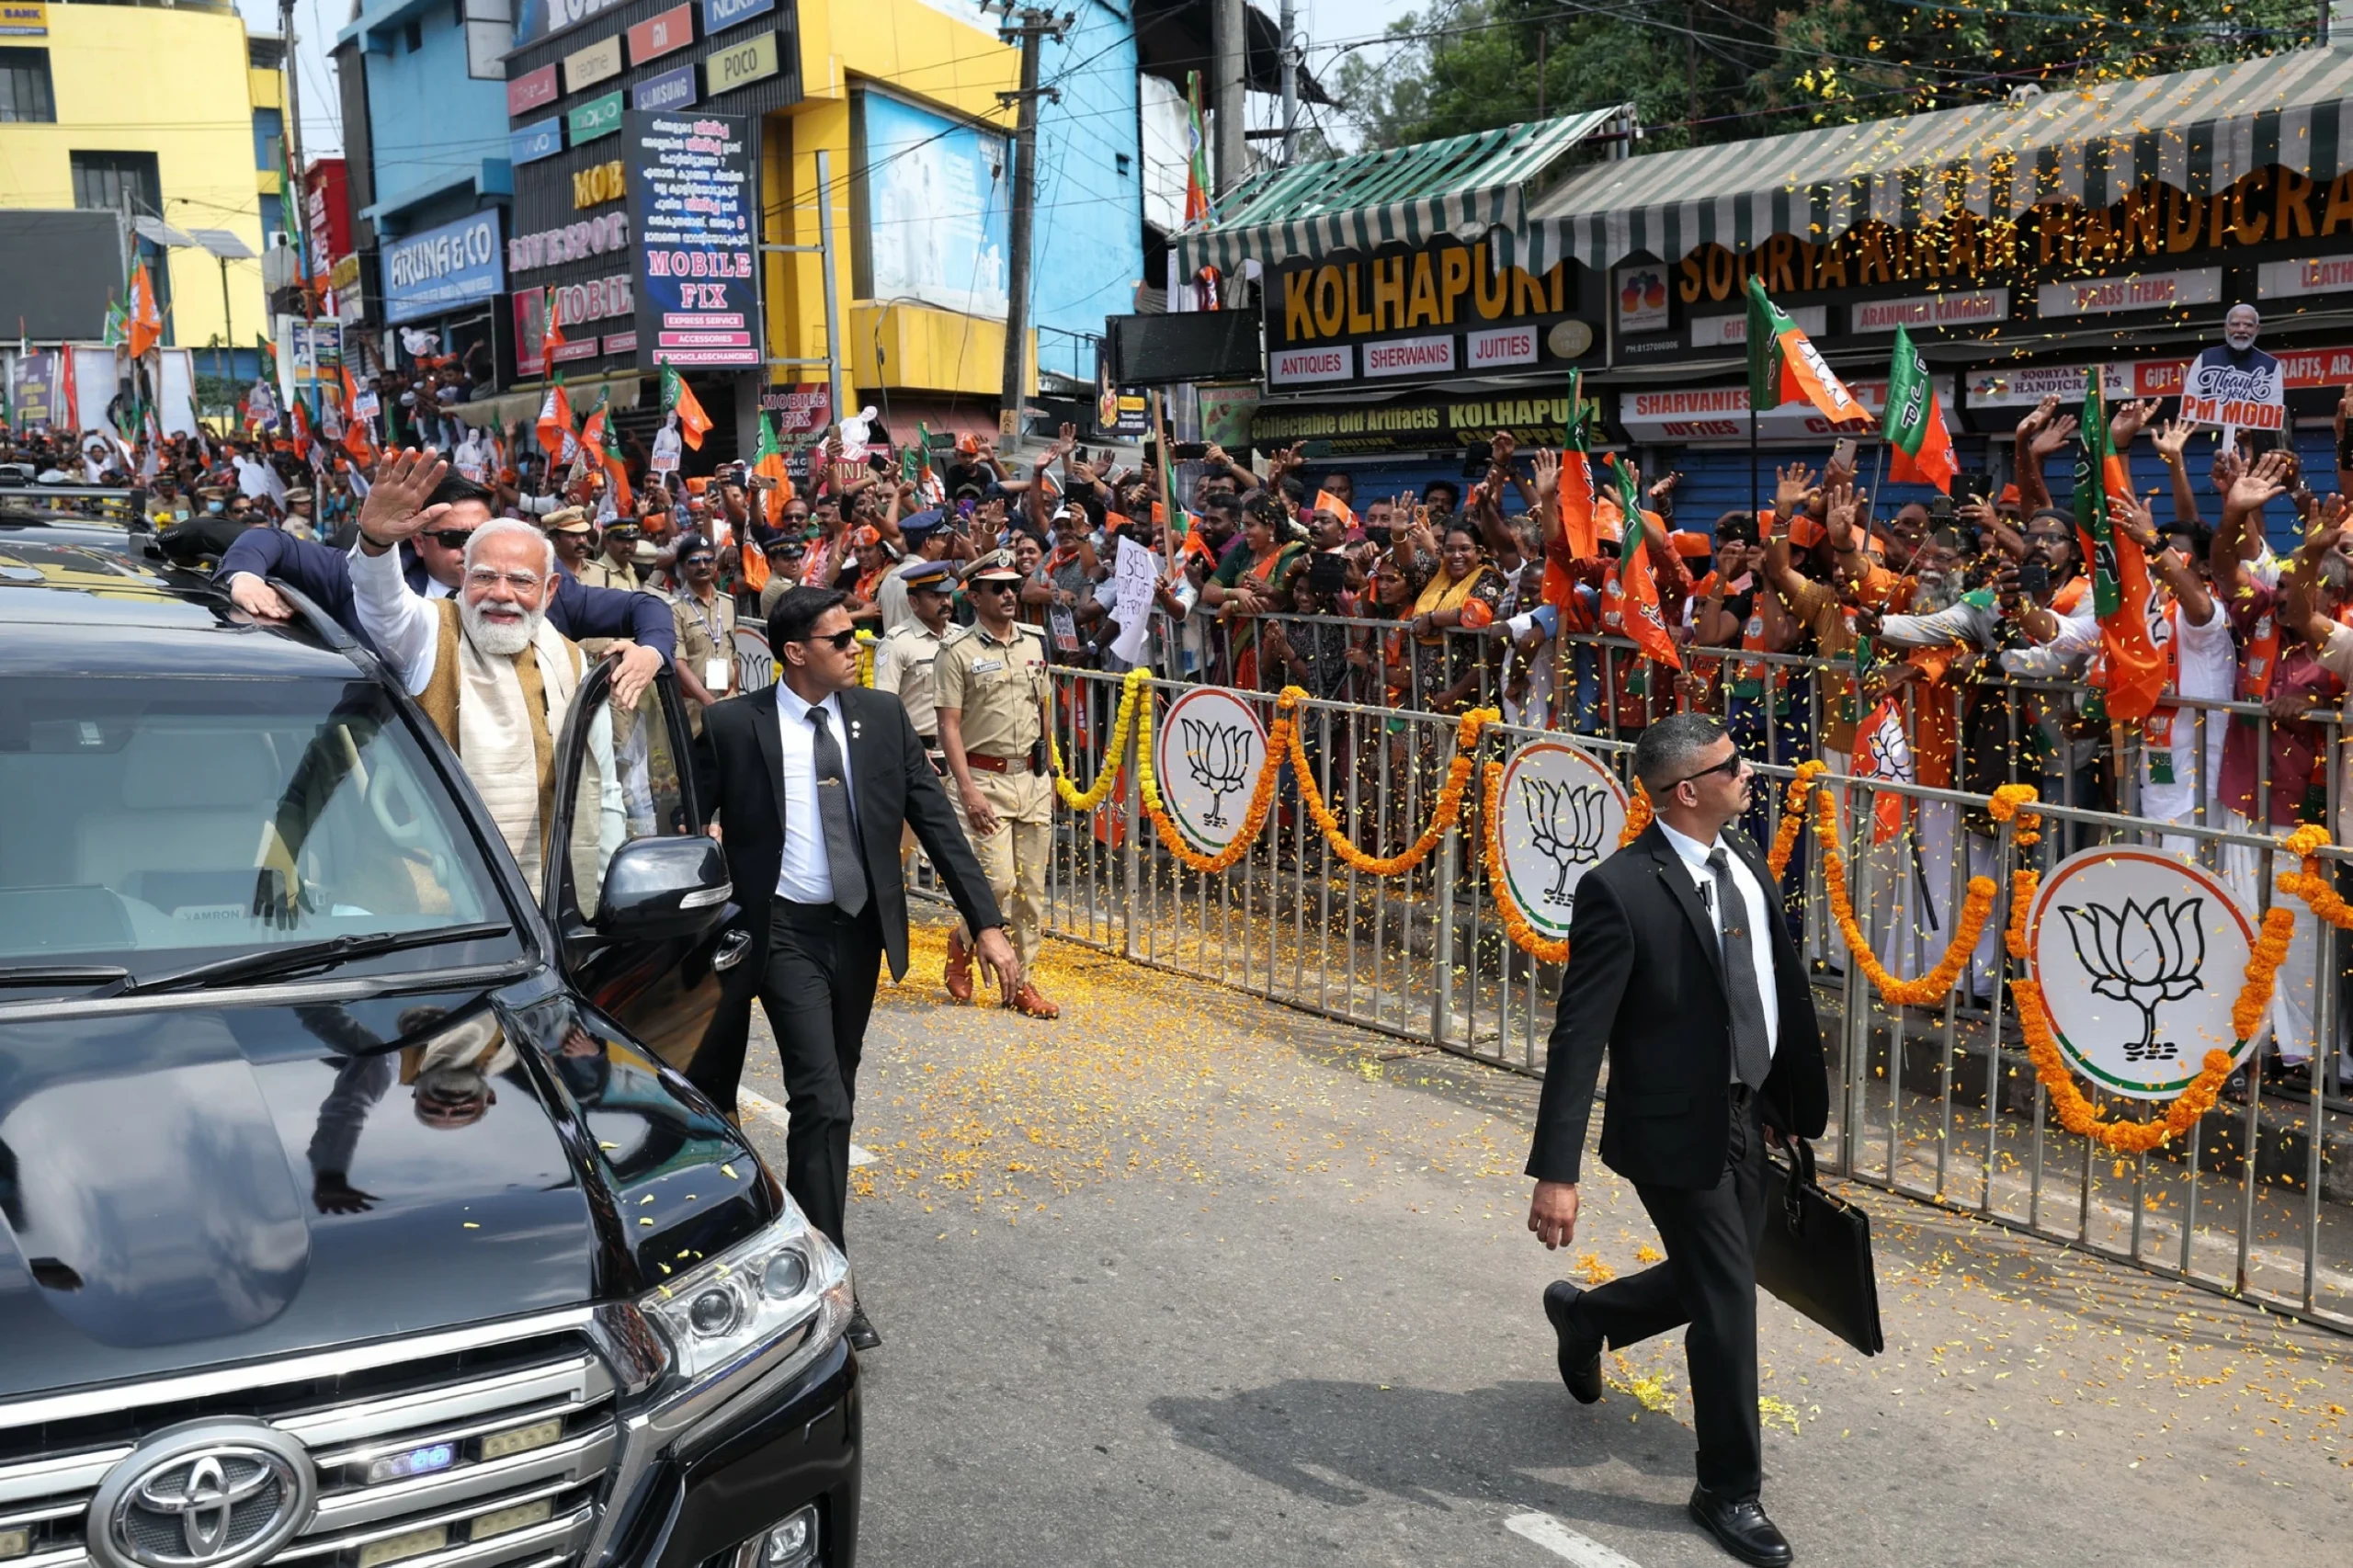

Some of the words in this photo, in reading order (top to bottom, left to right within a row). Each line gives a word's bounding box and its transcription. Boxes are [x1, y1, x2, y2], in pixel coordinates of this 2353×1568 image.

[5, 8, 40, 18] BANK
[711, 0, 763, 21] NOK
[724, 48, 757, 81] POCO
[640, 77, 688, 109] SAMSUNG
[509, 211, 629, 272] LIVESPOT
[392, 234, 450, 290] ARUNA
[451, 236, 465, 269] &
[465, 222, 493, 266] CO
[647, 250, 752, 278] MOBILE
[680, 282, 728, 309] FIX
[1284, 243, 1563, 341] KOLHAPURI
[2129, 278, 2175, 303] ITEMS
[706, 316, 739, 324] SERVICE
[1860, 305, 1930, 327] ARANMULA
[678, 335, 733, 343] ACCESSORIES
[1280, 354, 1341, 376] ANTIQUES
[1370, 344, 1449, 369] SHERWANIS
[2015, 376, 2122, 393] HANDICRATS
[2021, 368, 2071, 381] SOORYA
[2198, 365, 2273, 399] Thank
[763, 392, 827, 410] MOBILE
[1449, 397, 1601, 428] KOLHAPUI
[2182, 394, 2217, 421] PM
[2222, 400, 2285, 429] MODI
[781, 411, 811, 427] FIX
[1252, 414, 1336, 439] Collectable
[1339, 411, 1364, 433] old
[1367, 408, 1438, 430] Artifacts
[795, 432, 820, 442] SPOT
